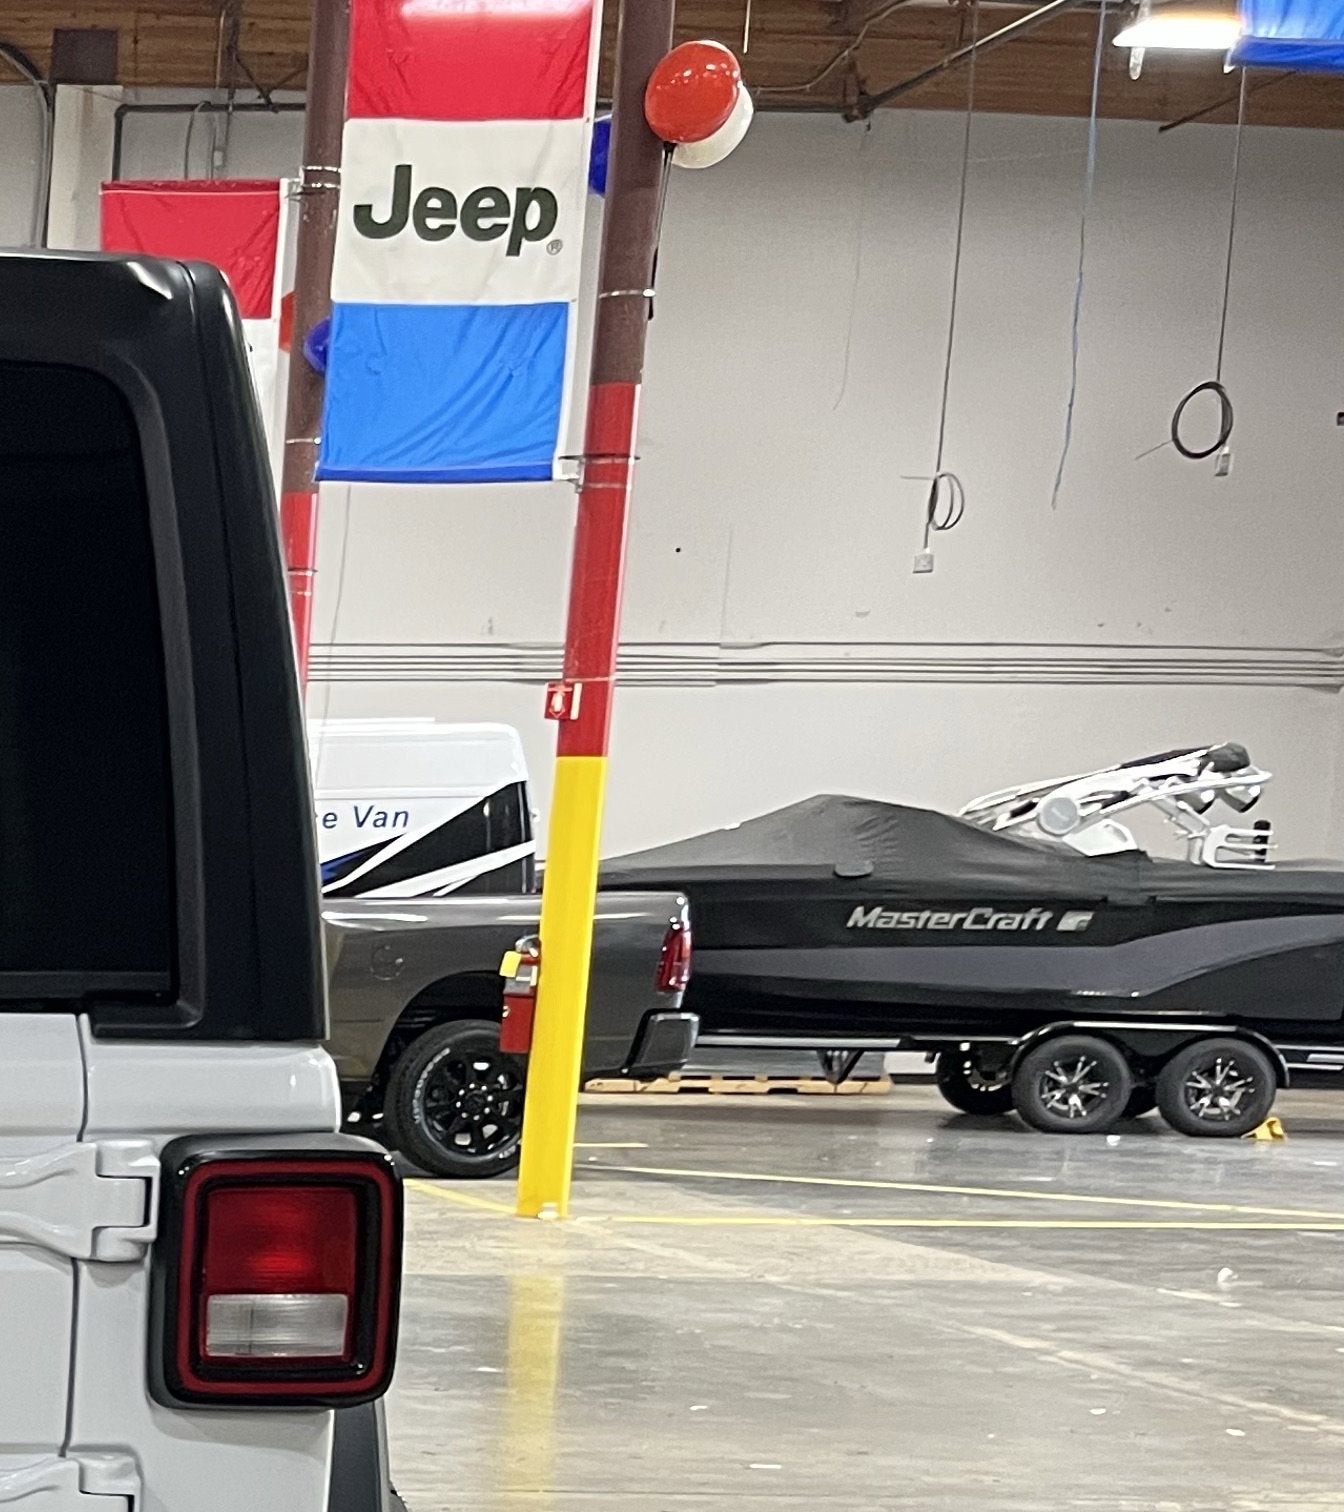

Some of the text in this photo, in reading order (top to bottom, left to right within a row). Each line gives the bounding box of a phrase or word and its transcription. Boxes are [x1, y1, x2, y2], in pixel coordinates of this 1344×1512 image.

[353, 164, 559, 257] Jeep
[353, 805, 409, 828] Van
[846, 906, 1053, 930] MasterCraft
